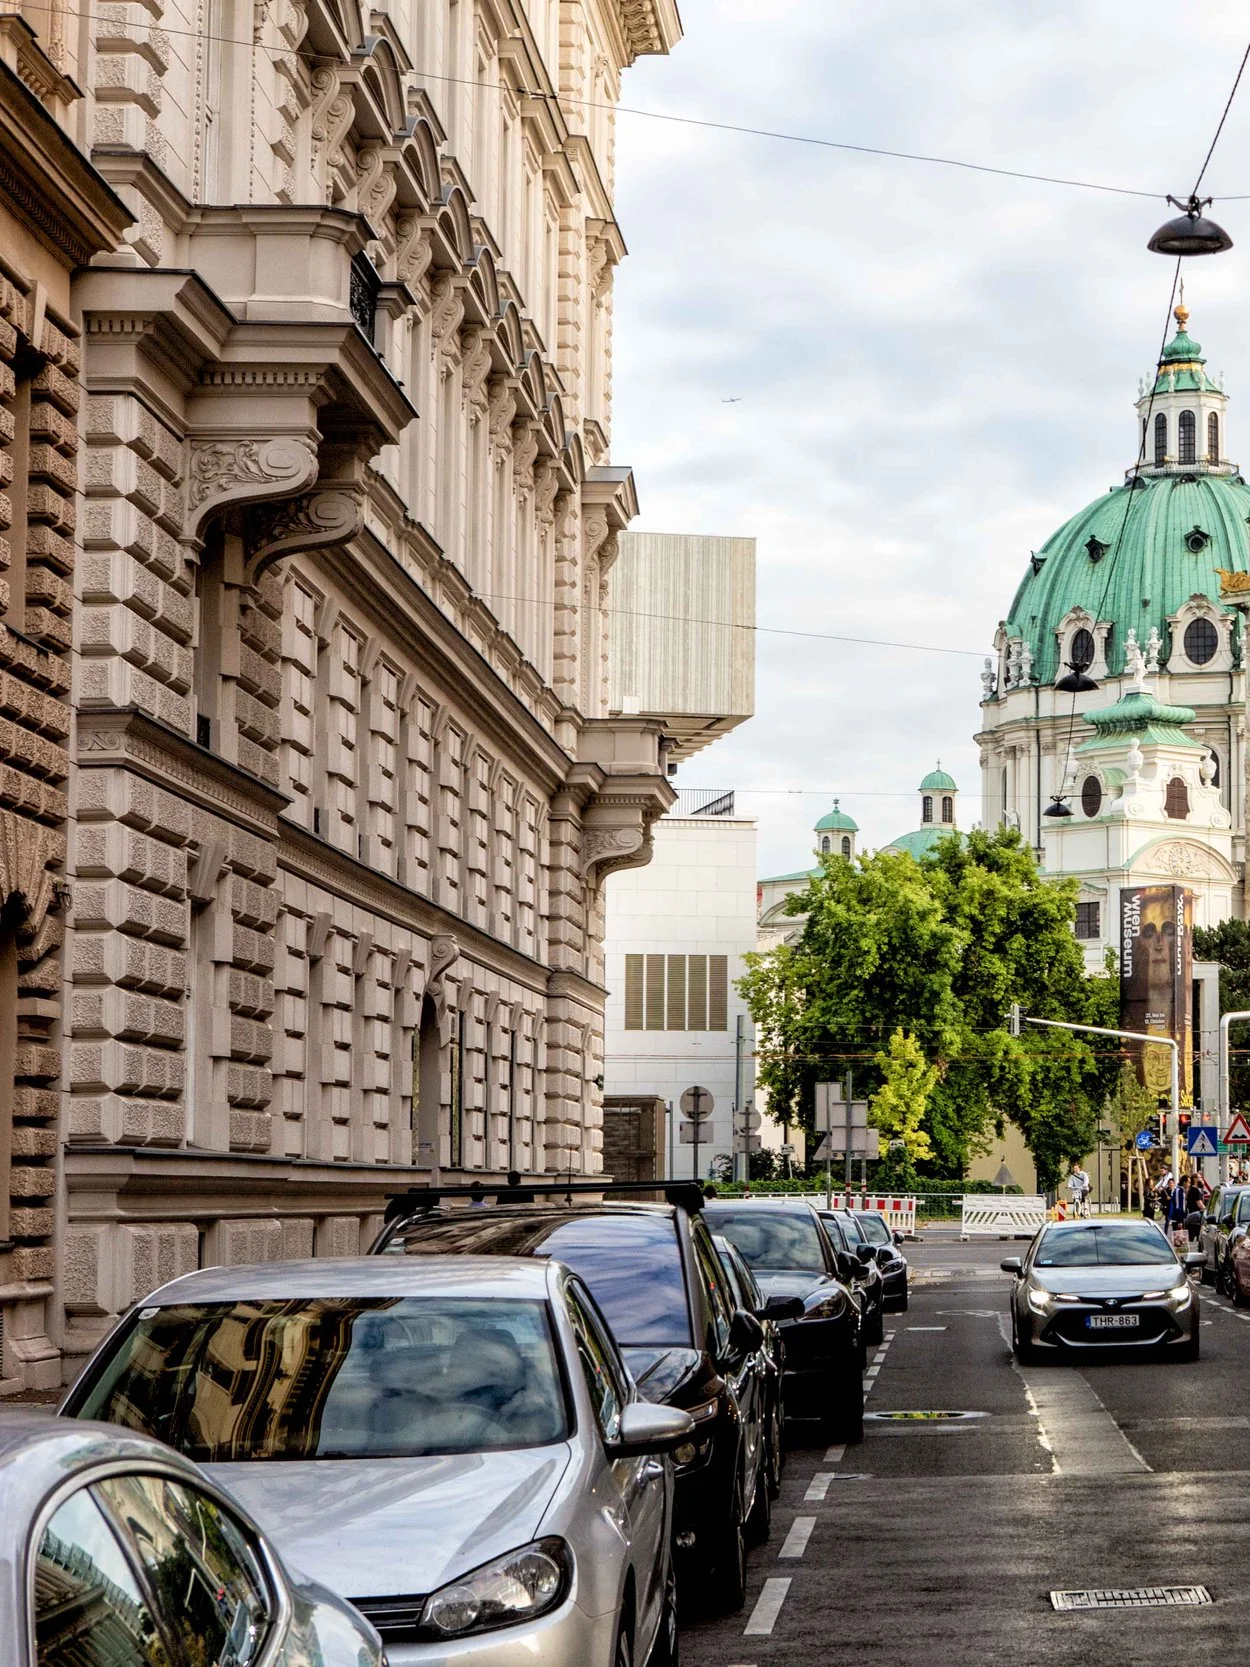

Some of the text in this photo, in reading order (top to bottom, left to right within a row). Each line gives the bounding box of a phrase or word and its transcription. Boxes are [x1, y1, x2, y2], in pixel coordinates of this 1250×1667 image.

[1132, 894, 1141, 937] Wien
[1123, 902, 1133, 978] Museum
[1093, 1315, 1138, 1326] THR-863
